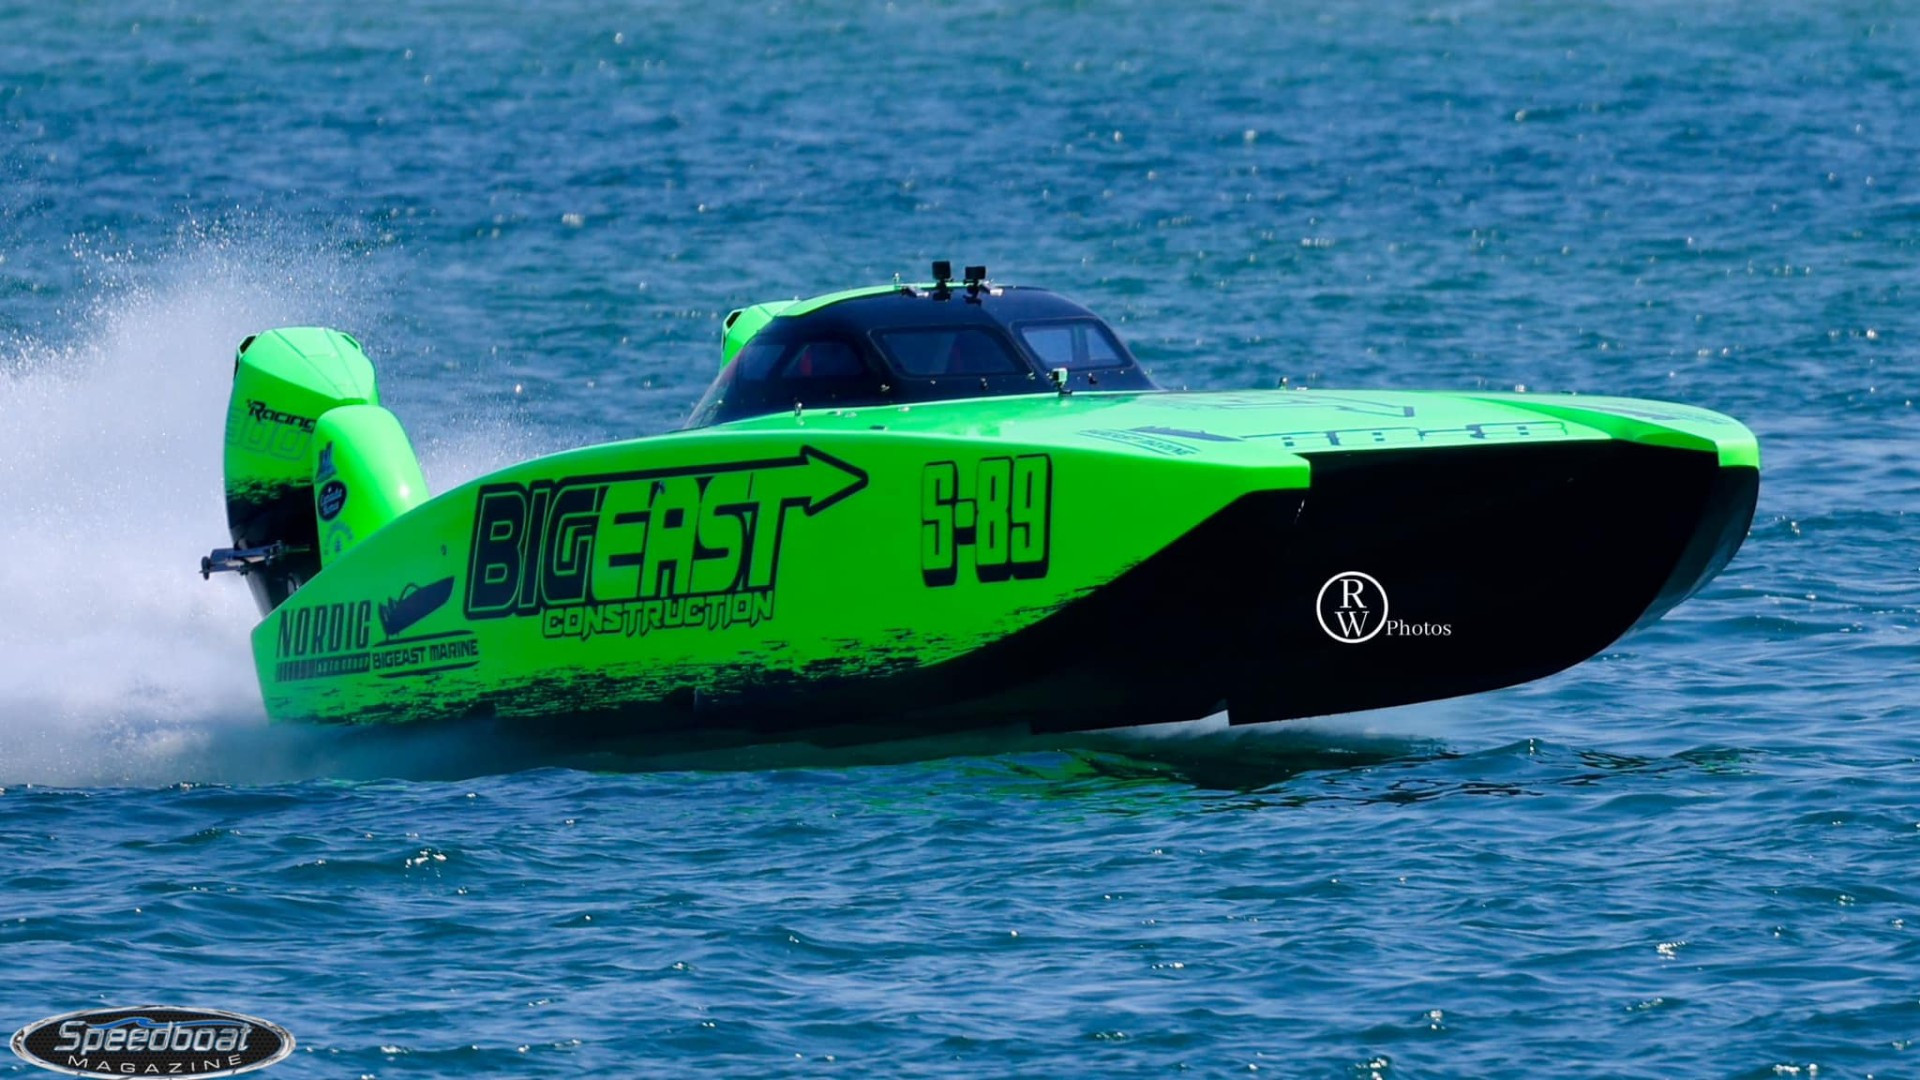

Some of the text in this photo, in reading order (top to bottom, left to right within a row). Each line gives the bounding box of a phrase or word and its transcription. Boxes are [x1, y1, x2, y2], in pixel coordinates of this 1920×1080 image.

[246, 399, 317, 433] Racing
[920, 453, 1053, 588] S-89
[275, 600, 372, 659] NORDIC
[542, 589, 776, 640] CONSTRUCTION
[372, 645, 427, 670] BIGEAST
[429, 638, 479, 662] MARINE
